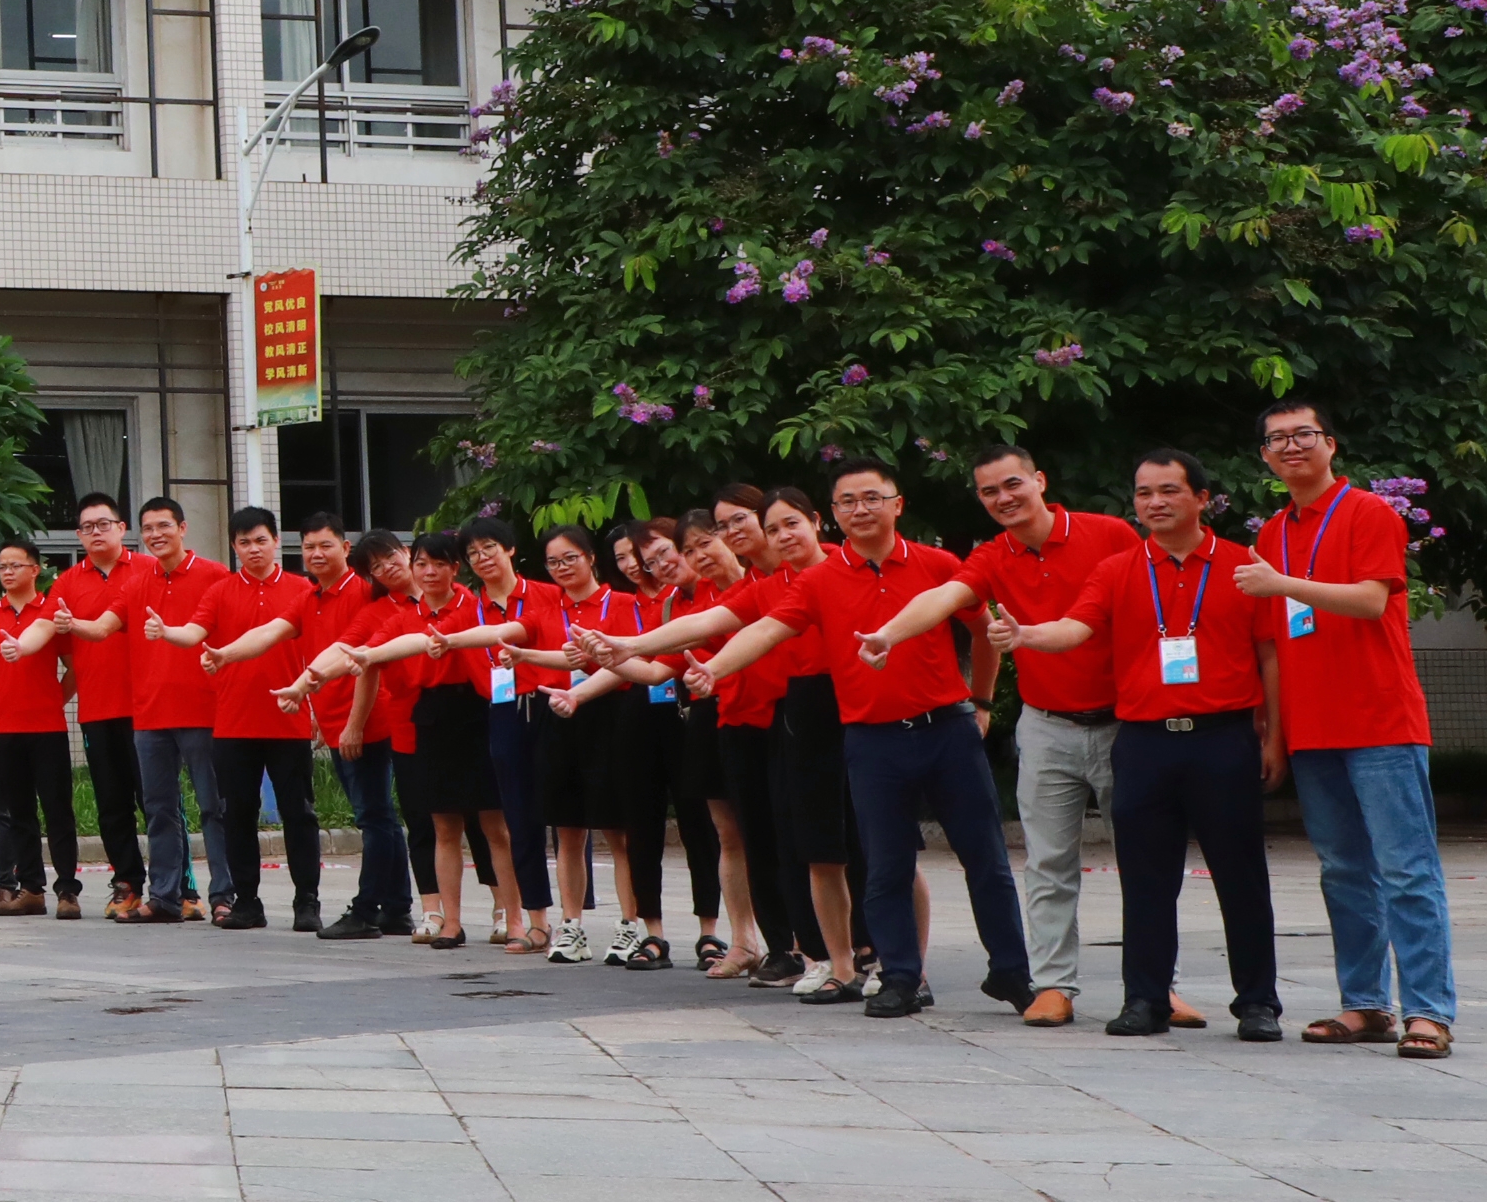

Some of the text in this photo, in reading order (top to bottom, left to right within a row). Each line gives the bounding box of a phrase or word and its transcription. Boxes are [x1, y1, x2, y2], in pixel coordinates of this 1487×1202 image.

[263, 296, 306, 314] 党风优良
[264, 319, 307, 336] 校风清明
[265, 364, 307, 381] 学风清新
